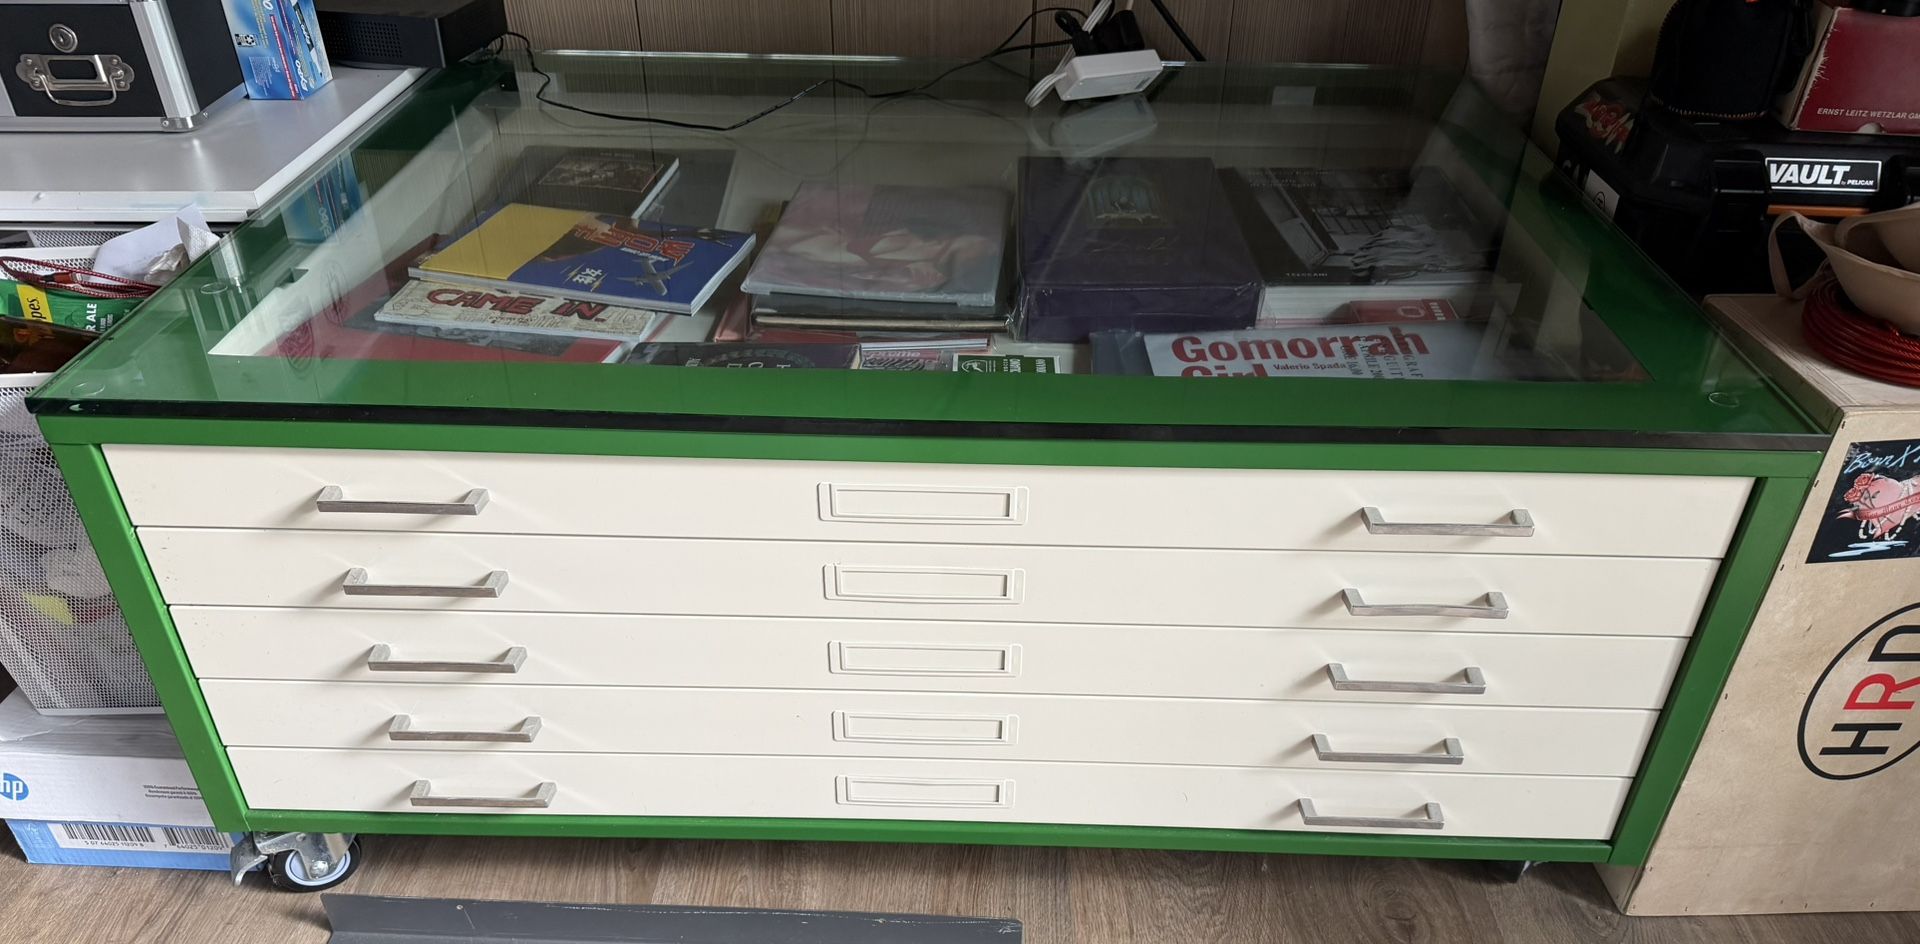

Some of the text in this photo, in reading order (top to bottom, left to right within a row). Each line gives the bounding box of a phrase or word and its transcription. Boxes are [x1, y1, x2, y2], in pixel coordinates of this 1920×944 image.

[1817, 107, 1845, 116] ERNST
[1845, 109, 1869, 118] LEITZ
[1869, 110, 1908, 119] WETZLAR
[1769, 163, 1851, 185] VAULT
[86, 302, 97, 322] ALE
[427, 288, 546, 315] CAME
[1171, 326, 1430, 363] Gomorrah
[1273, 362, 1347, 371] Valerio Spada
[1843, 452, 1894, 474] Born
[1819, 625, 1920, 756] HRD
[0, 773, 24, 800] hp
